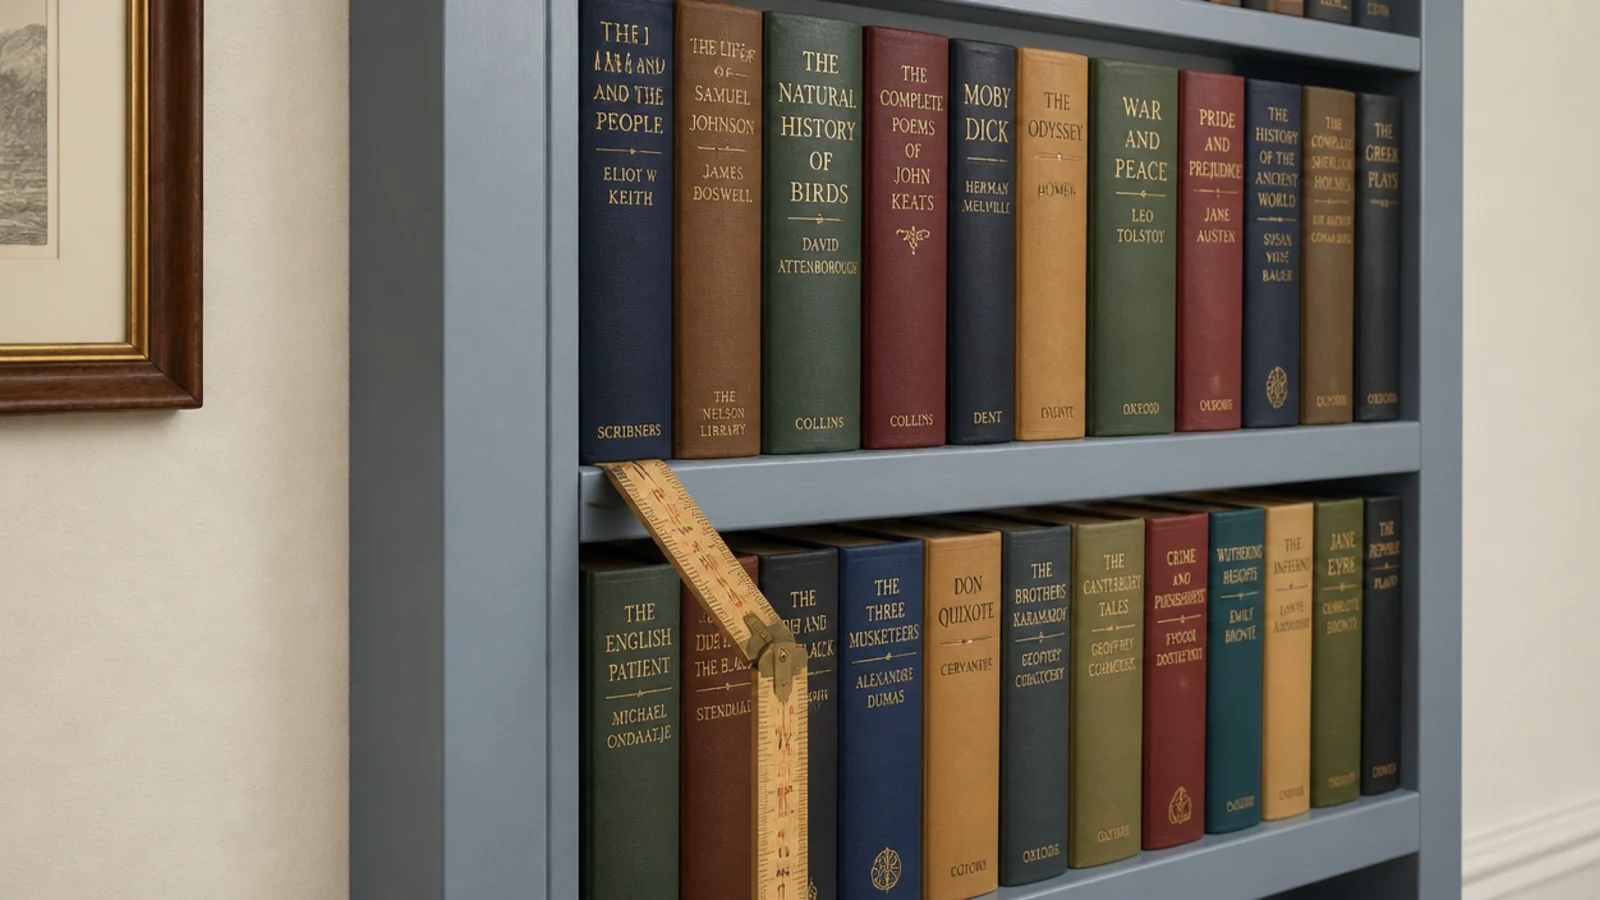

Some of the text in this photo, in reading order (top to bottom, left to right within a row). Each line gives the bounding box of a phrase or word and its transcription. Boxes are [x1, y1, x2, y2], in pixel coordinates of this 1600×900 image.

[601, 21, 638, 44] THE
[690, 37, 716, 56] THE
[802, 50, 838, 74] THE
[901, 64, 928, 83] THE
[593, 84, 629, 102] AND
[694, 86, 750, 106] SAMUEL
[778, 82, 857, 109] NATURAL
[880, 89, 944, 112] COMPLETE
[964, 83, 1012, 108] MOBY
[1044, 92, 1070, 111] THE
[1122, 96, 1162, 121] WAR
[1268, 106, 1289, 122] THE
[595, 112, 664, 134] PEOPLE
[689, 114, 755, 135] JOHNSON
[892, 117, 935, 136] POEMS
[1199, 108, 1236, 129] PRIDE
[780, 116, 856, 141] HISTORY
[965, 117, 1009, 144] DICK
[1028, 120, 1084, 142] ODYSSEY
[1125, 130, 1160, 150] AND
[1204, 136, 1230, 152] AND
[905, 143, 922, 159] OF
[1259, 150, 1295, 167] OF THE
[809, 151, 833, 171] OF
[1115, 158, 1168, 182] PEACE
[603, 166, 658, 182] ELIOT W
[702, 164, 744, 180] JAMES
[894, 166, 930, 184] JOHN
[1368, 172, 1398, 190] PLAYS
[608, 190, 653, 206] KEITH
[790, 181, 848, 204] BIRDS
[892, 193, 934, 211] KEATS
[1258, 192, 1296, 208] WORLD
[1132, 208, 1154, 222] LEO
[1204, 207, 1230, 222] JANE
[802, 237, 839, 252] DAVID
[1117, 228, 1165, 244] TOLSTOY
[1196, 230, 1236, 244] AUSTEN
[714, 390, 736, 403] THE
[702, 407, 745, 420] NELSON
[890, 414, 934, 428] COLLINS
[974, 410, 1002, 424] DENT
[597, 424, 662, 439] SCRIBNERS
[795, 416, 844, 431] COLLINS
[1284, 537, 1302, 552] THE
[1330, 531, 1356, 551] JANE
[1104, 554, 1124, 570] THE
[1166, 548, 1196, 566] CRIME
[1328, 556, 1356, 576] EYRE
[1031, 562, 1052, 579] THE
[874, 578, 900, 596] THE
[954, 576, 982, 596] DON
[1015, 584, 1066, 604] BROTHERS
[790, 589, 816, 608] THE
[1098, 598, 1129, 617] TALES
[625, 602, 655, 624] THE
[866, 602, 905, 622] THREE
[938, 602, 994, 628] QUIXOTE
[605, 628, 672, 653] ENGLISH
[849, 624, 920, 648] MUSKETEERS
[608, 656, 670, 682] PATIENT
[695, 659, 718, 678] THE
[867, 690, 904, 708] DUMAS
[612, 704, 667, 726] MICHAEL
